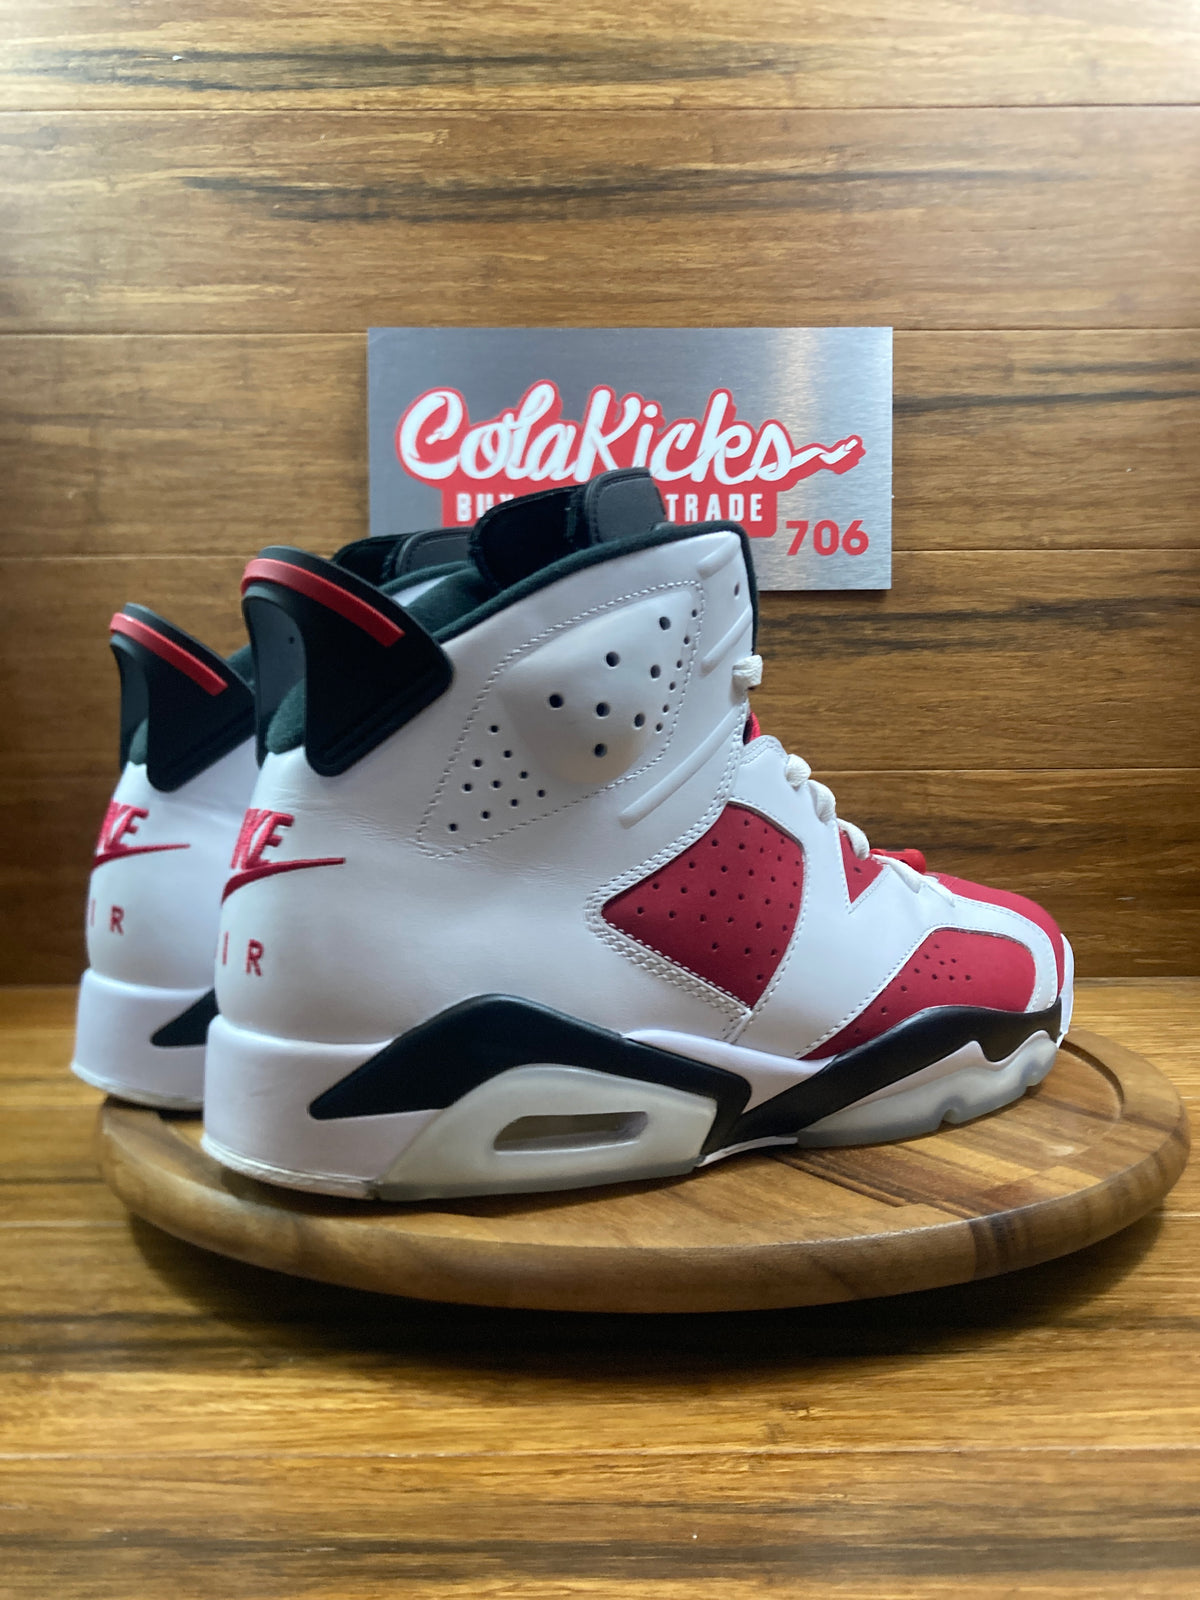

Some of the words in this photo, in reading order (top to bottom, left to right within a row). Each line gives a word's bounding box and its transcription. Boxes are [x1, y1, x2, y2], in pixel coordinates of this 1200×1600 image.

[399, 379, 859, 485] ColaKicks
[456, 493, 515, 521] BU
[665, 493, 763, 522] TRADE
[786, 520, 869, 556] 706
[214, 930, 264, 977] IR
